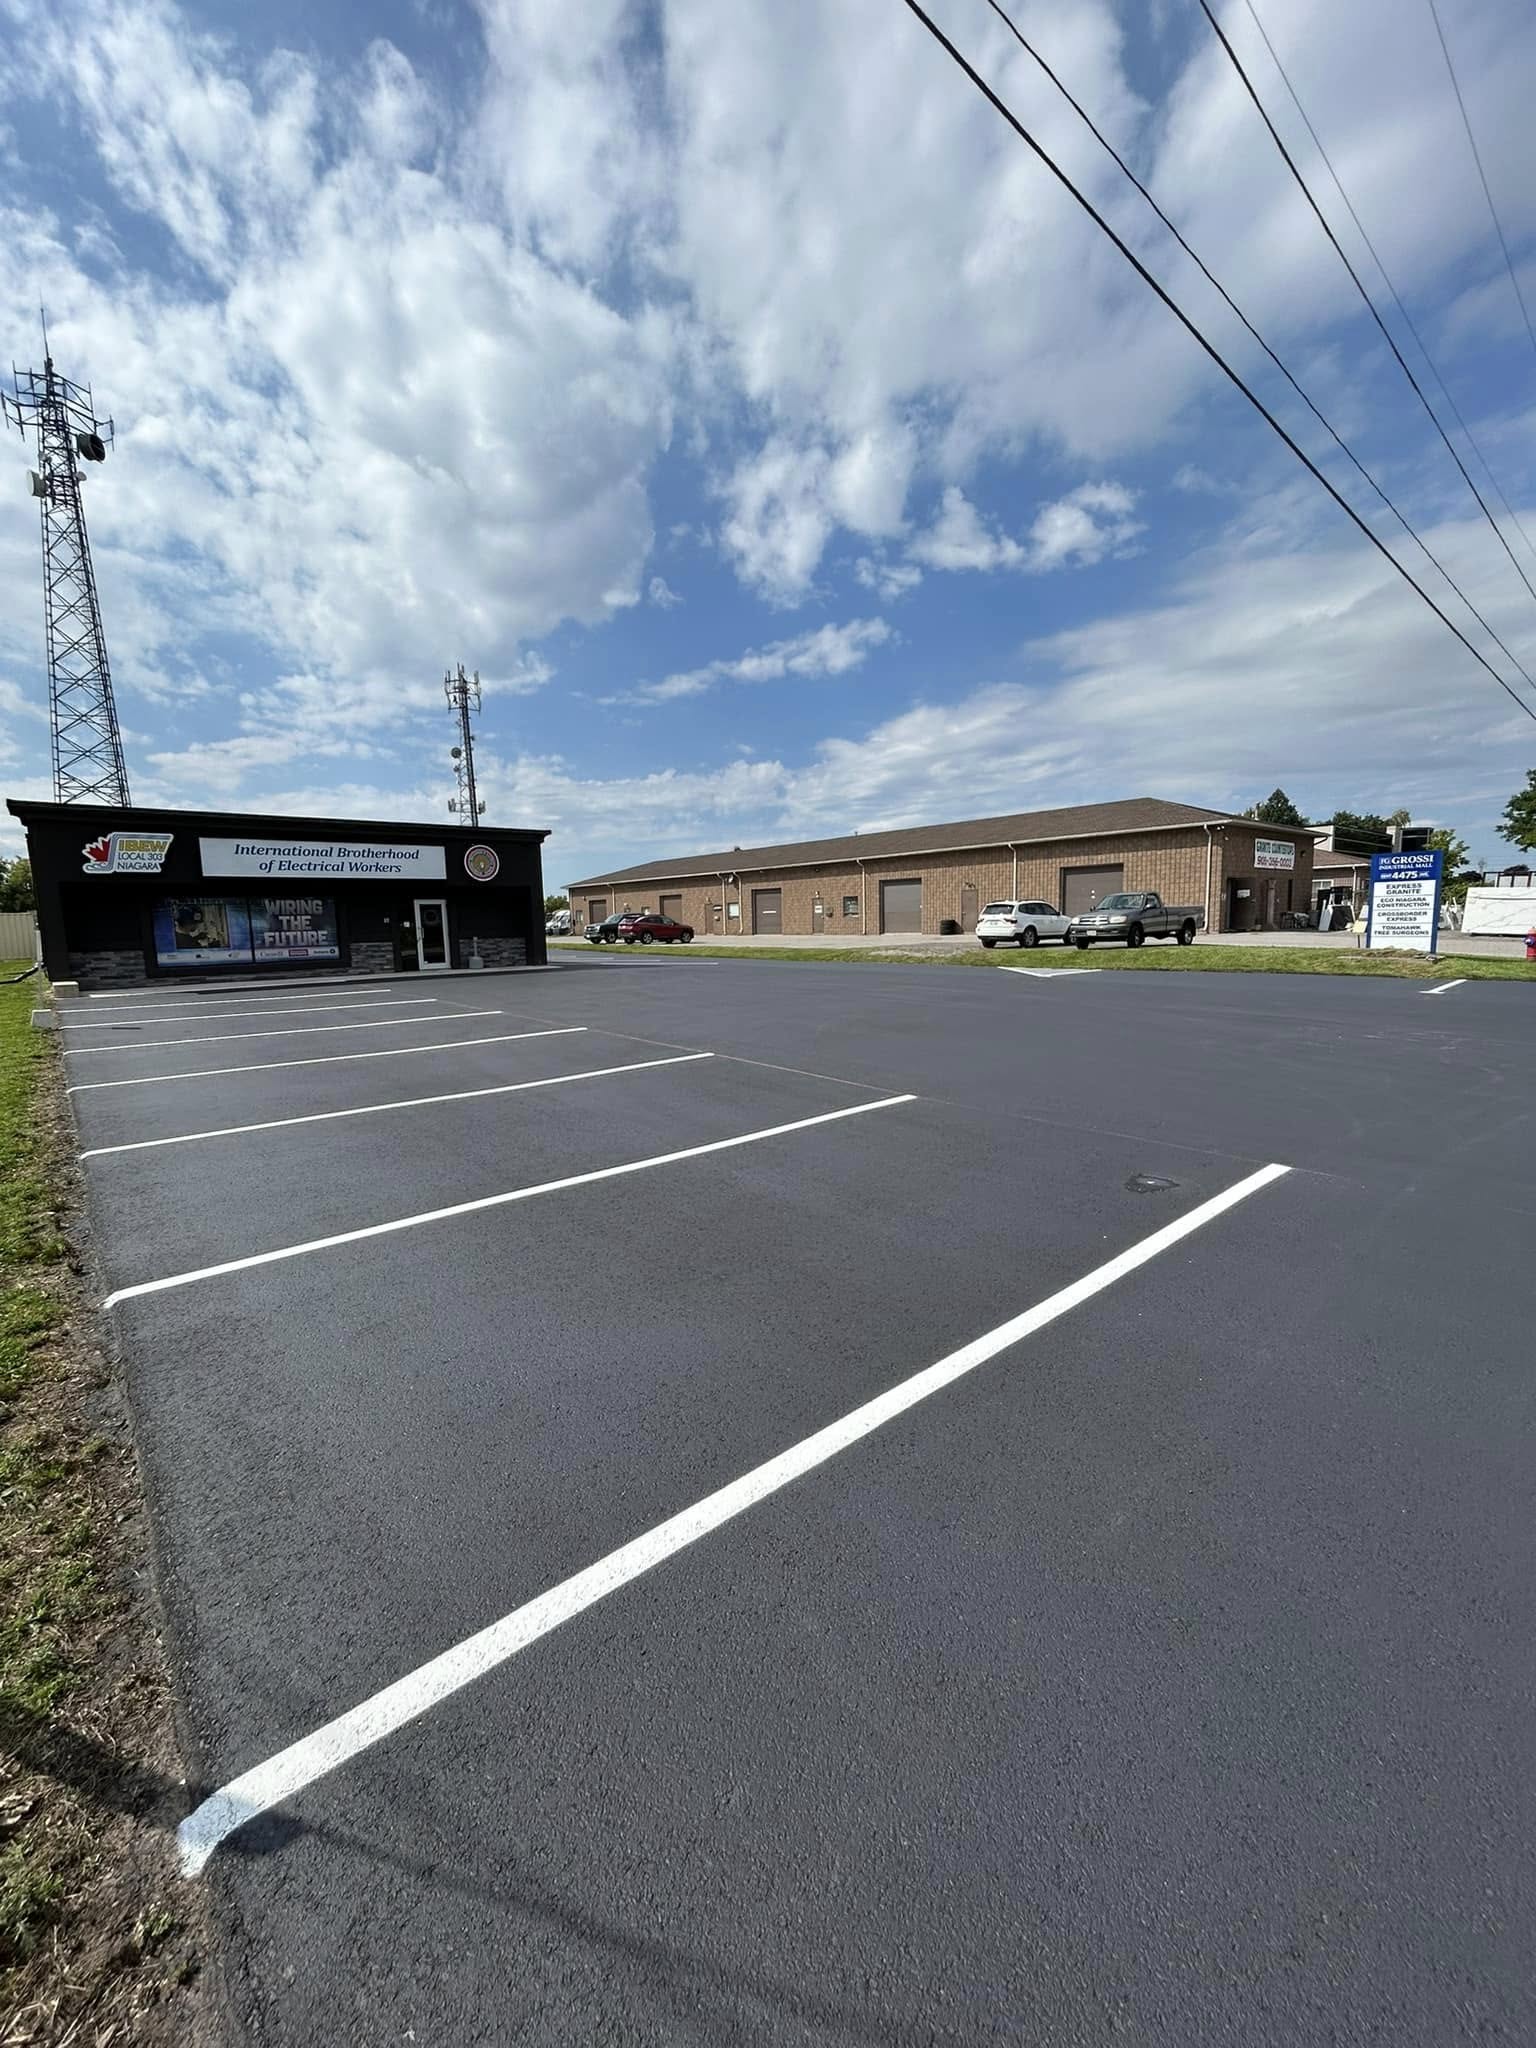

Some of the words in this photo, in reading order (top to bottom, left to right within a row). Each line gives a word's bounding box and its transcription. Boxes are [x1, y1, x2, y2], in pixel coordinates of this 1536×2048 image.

[118, 840, 169, 851] IBEW
[118, 852, 146, 860] LOCAL
[235, 844, 333, 857] International
[337, 847, 419, 860] Brotherhood
[1391, 855, 1434, 864] GROSSI
[118, 862, 159, 870] NIAGARA
[260, 860, 275, 873] of
[278, 860, 345, 872] Electrical
[349, 862, 402, 872] Workers
[1391, 871, 1418, 879] 4475
[264, 899, 323, 915] WIRING
[278, 915, 312, 930] THE
[264, 931, 329, 947] FUTURE
